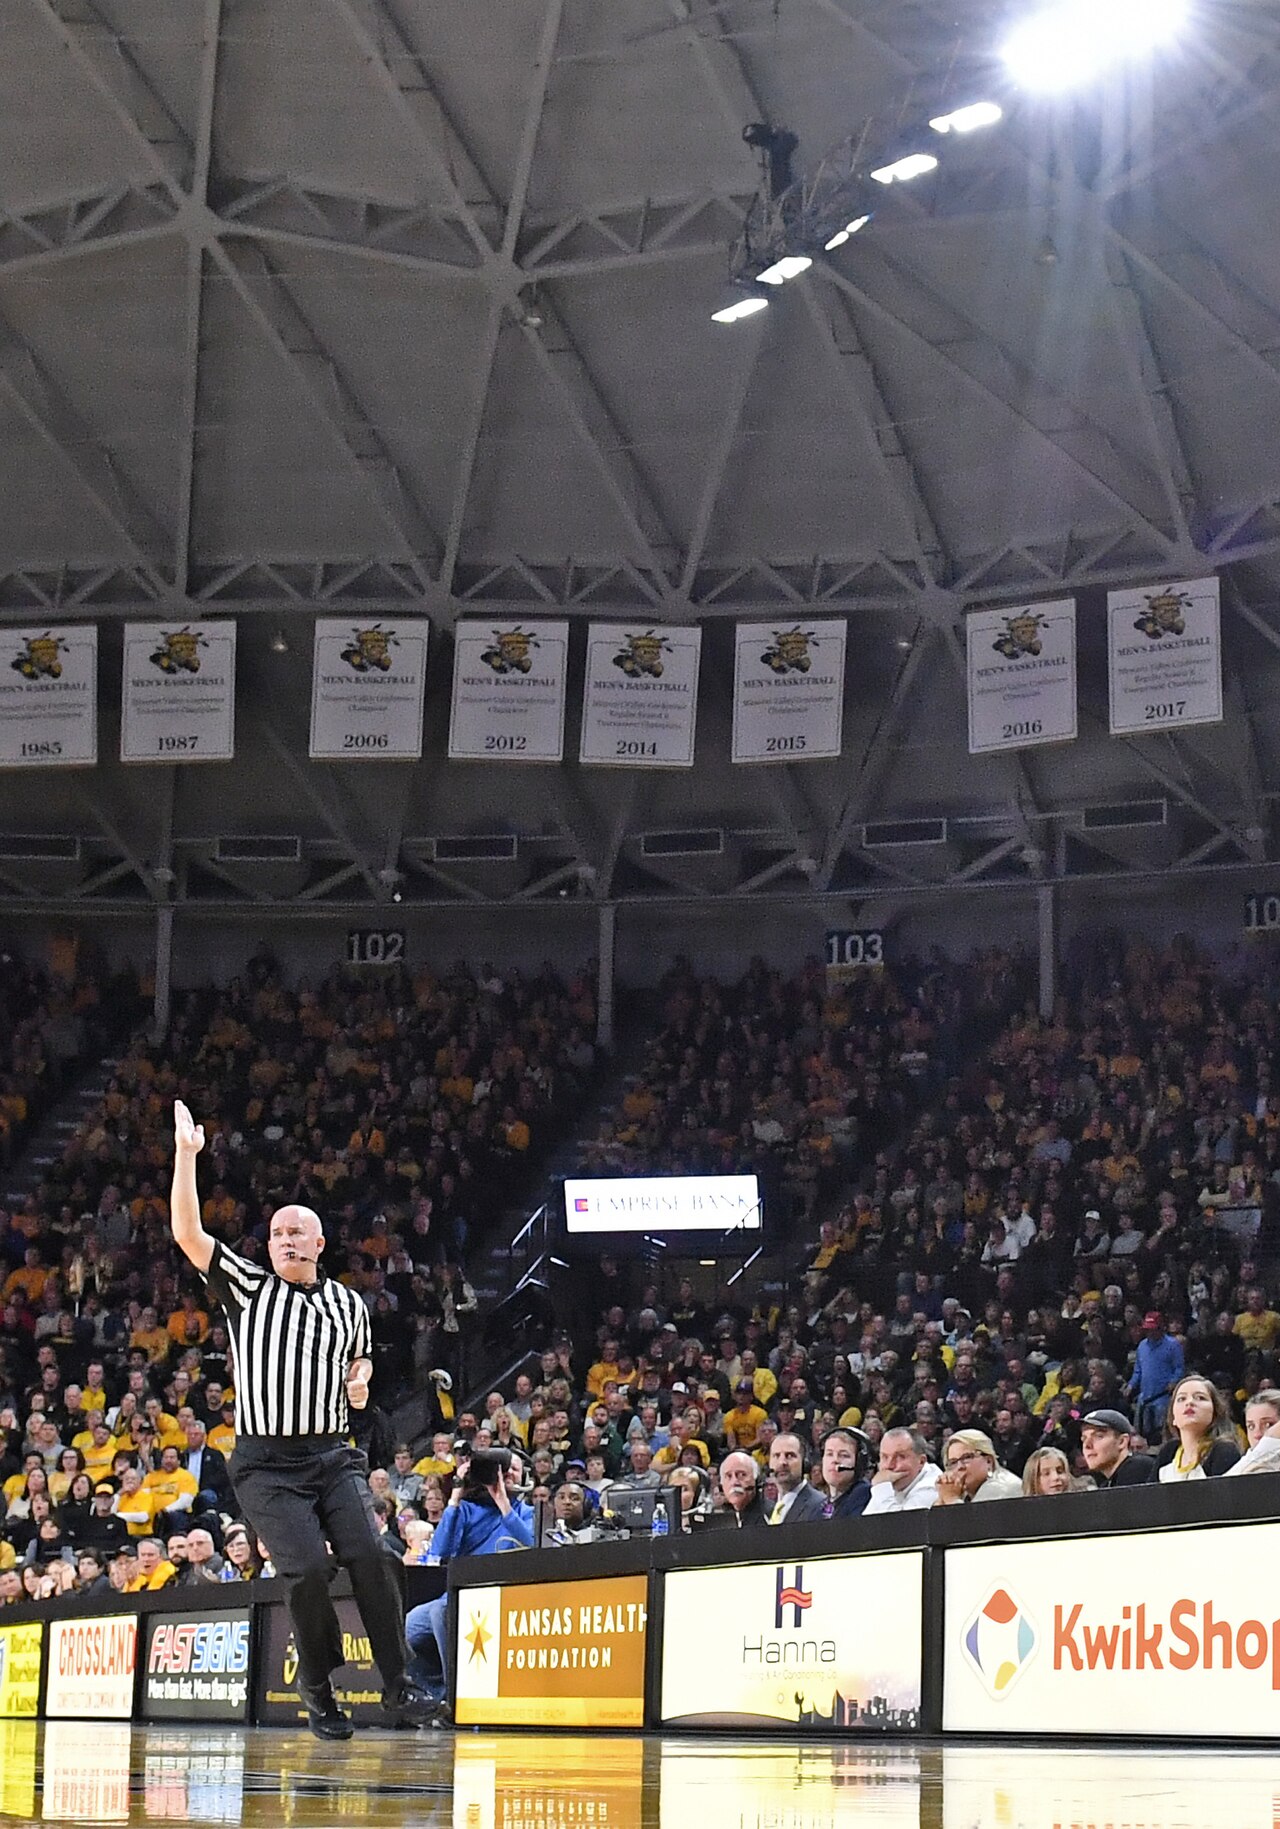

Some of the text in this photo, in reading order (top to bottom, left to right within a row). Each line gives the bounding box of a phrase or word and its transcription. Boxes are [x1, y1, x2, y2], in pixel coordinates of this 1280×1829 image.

[1148, 637, 1210, 652] BASKETBALL
[1008, 656, 1068, 672] BASKETBALL
[626, 682, 689, 692] BASKETBALL
[774, 676, 836, 686] BASKETBALL
[1145, 702, 1186, 719] 2017
[1002, 720, 1042, 738] 2016
[157, 736, 199, 750] 1987
[343, 734, 388, 748] 2006
[485, 736, 527, 750] 2012
[616, 741, 657, 755] 2014
[766, 735, 806, 751] 2015
[21, 742, 63, 757] 1985
[350, 933, 403, 964] 102
[829, 934, 882, 965] 103
[508, 1606, 573, 1637] KANSAS
[59, 1624, 136, 1676] CROSSLAND
[148, 1621, 250, 1673] FASTSIGNS
[743, 1635, 836, 1663] Hanna
[506, 1647, 612, 1670] FOUNDATION
